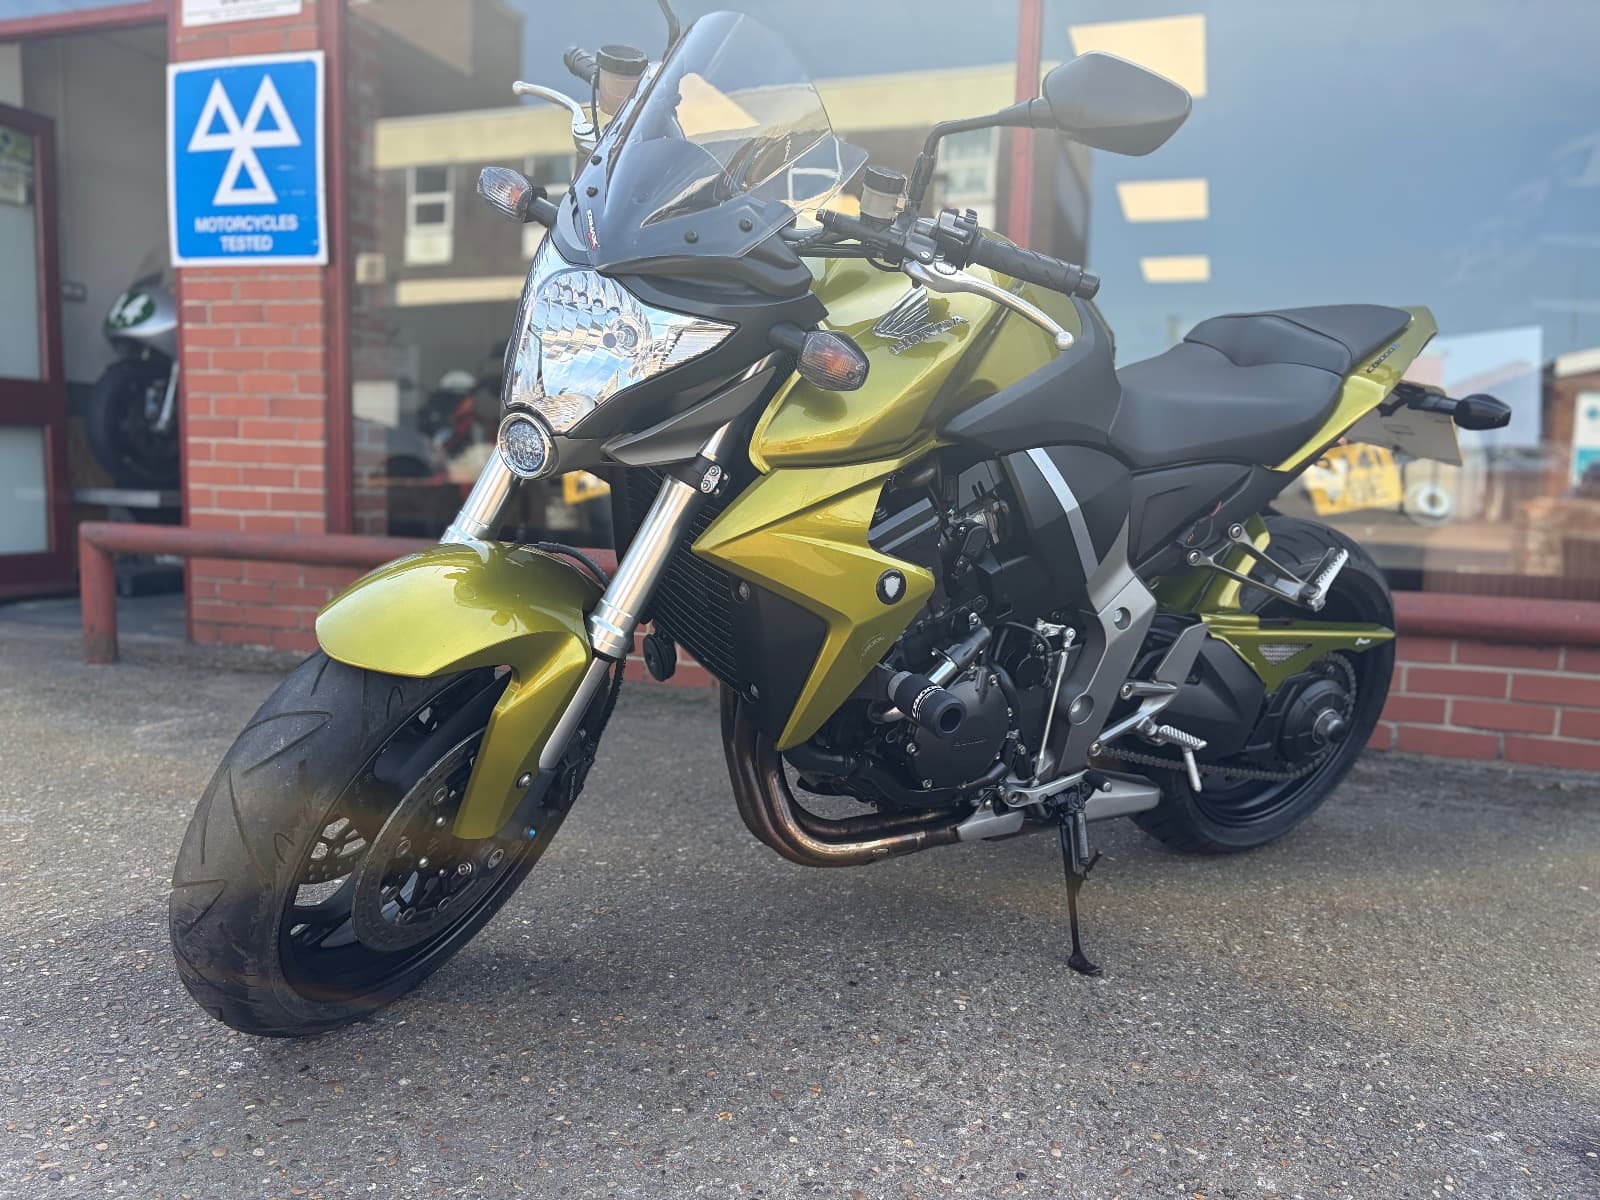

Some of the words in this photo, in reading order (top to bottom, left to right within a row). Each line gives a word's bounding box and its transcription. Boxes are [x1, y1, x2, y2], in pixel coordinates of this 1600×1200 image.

[194, 214, 299, 233] MOTORCYCLES
[220, 235, 273, 252] TESTED
[889, 315, 969, 355] HONDA
